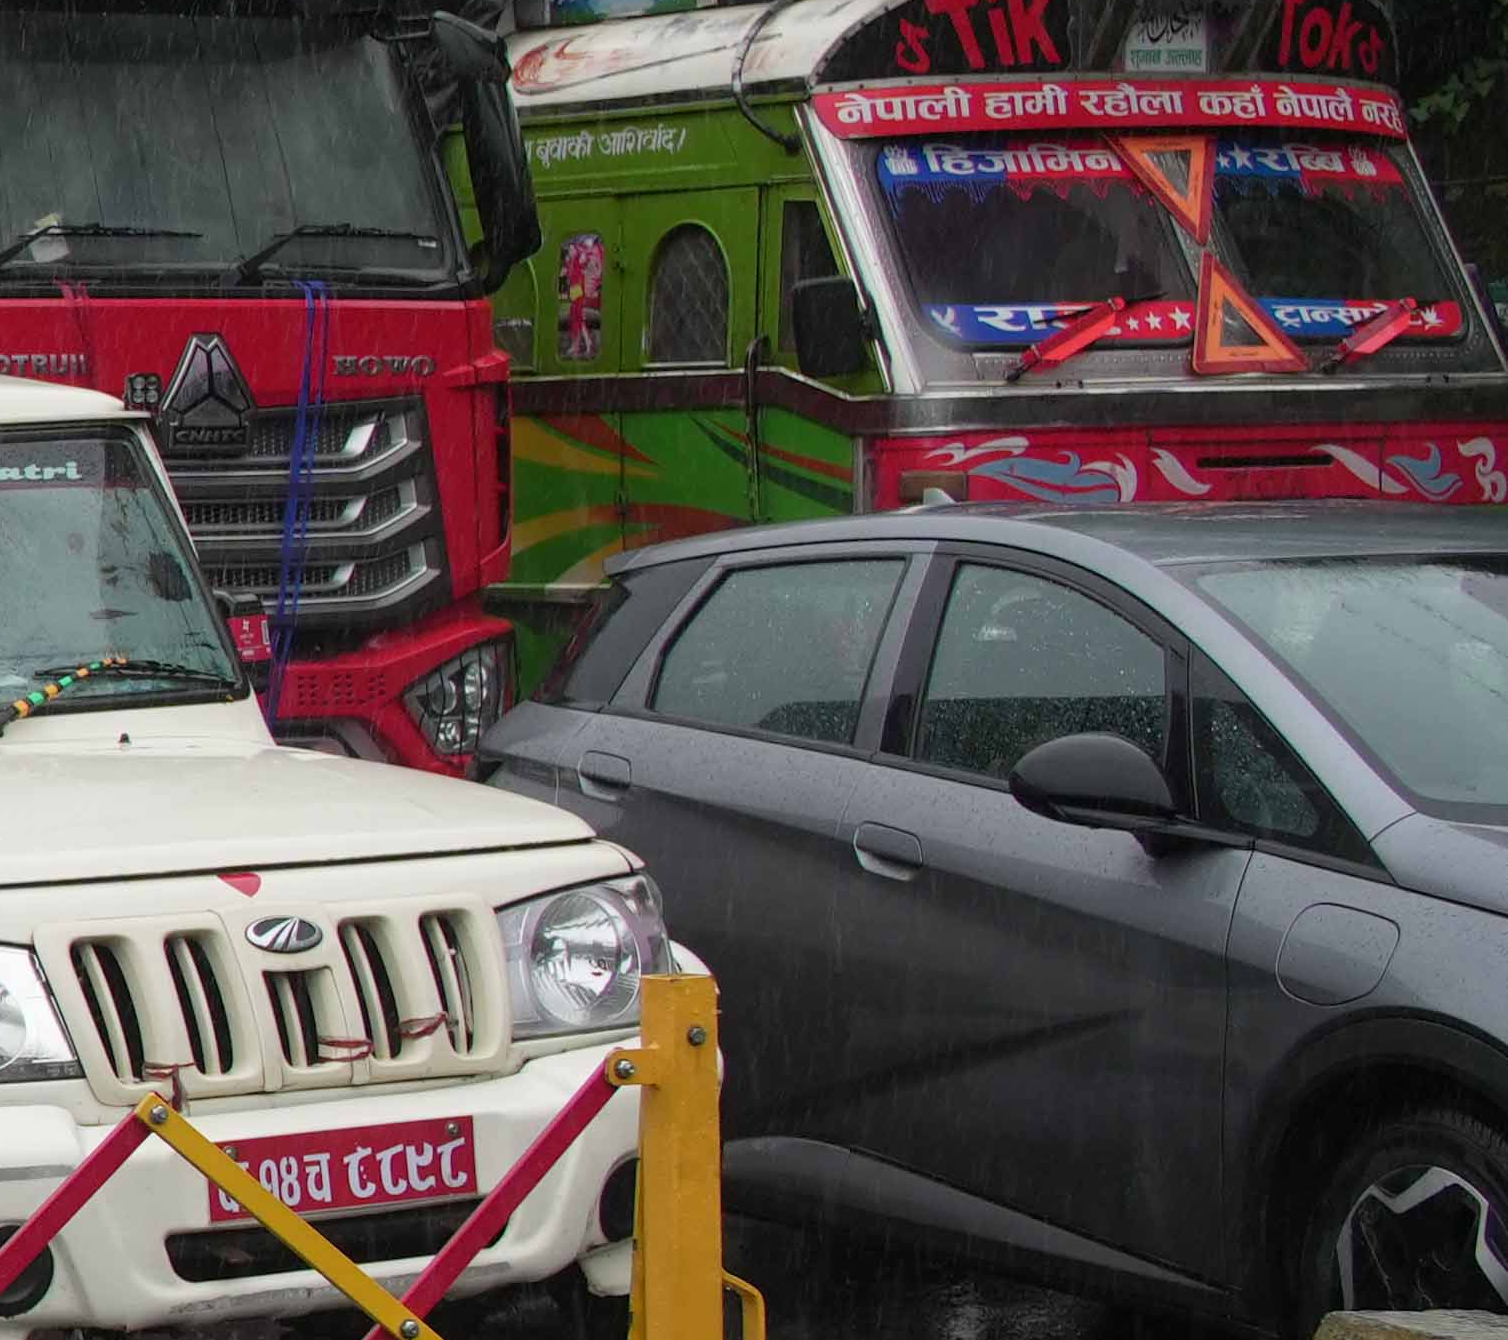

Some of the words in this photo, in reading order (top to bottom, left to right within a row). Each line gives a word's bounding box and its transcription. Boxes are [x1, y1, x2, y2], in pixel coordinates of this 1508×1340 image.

[834, 86, 972, 125] नेपाली
[984, 83, 1068, 119] हामी
[1198, 83, 1267, 119] कहाँ
[1273, 84, 1354, 123] नेपालै
[332, 354, 436, 376] HOWO
[176, 427, 245, 444] CNHTC
